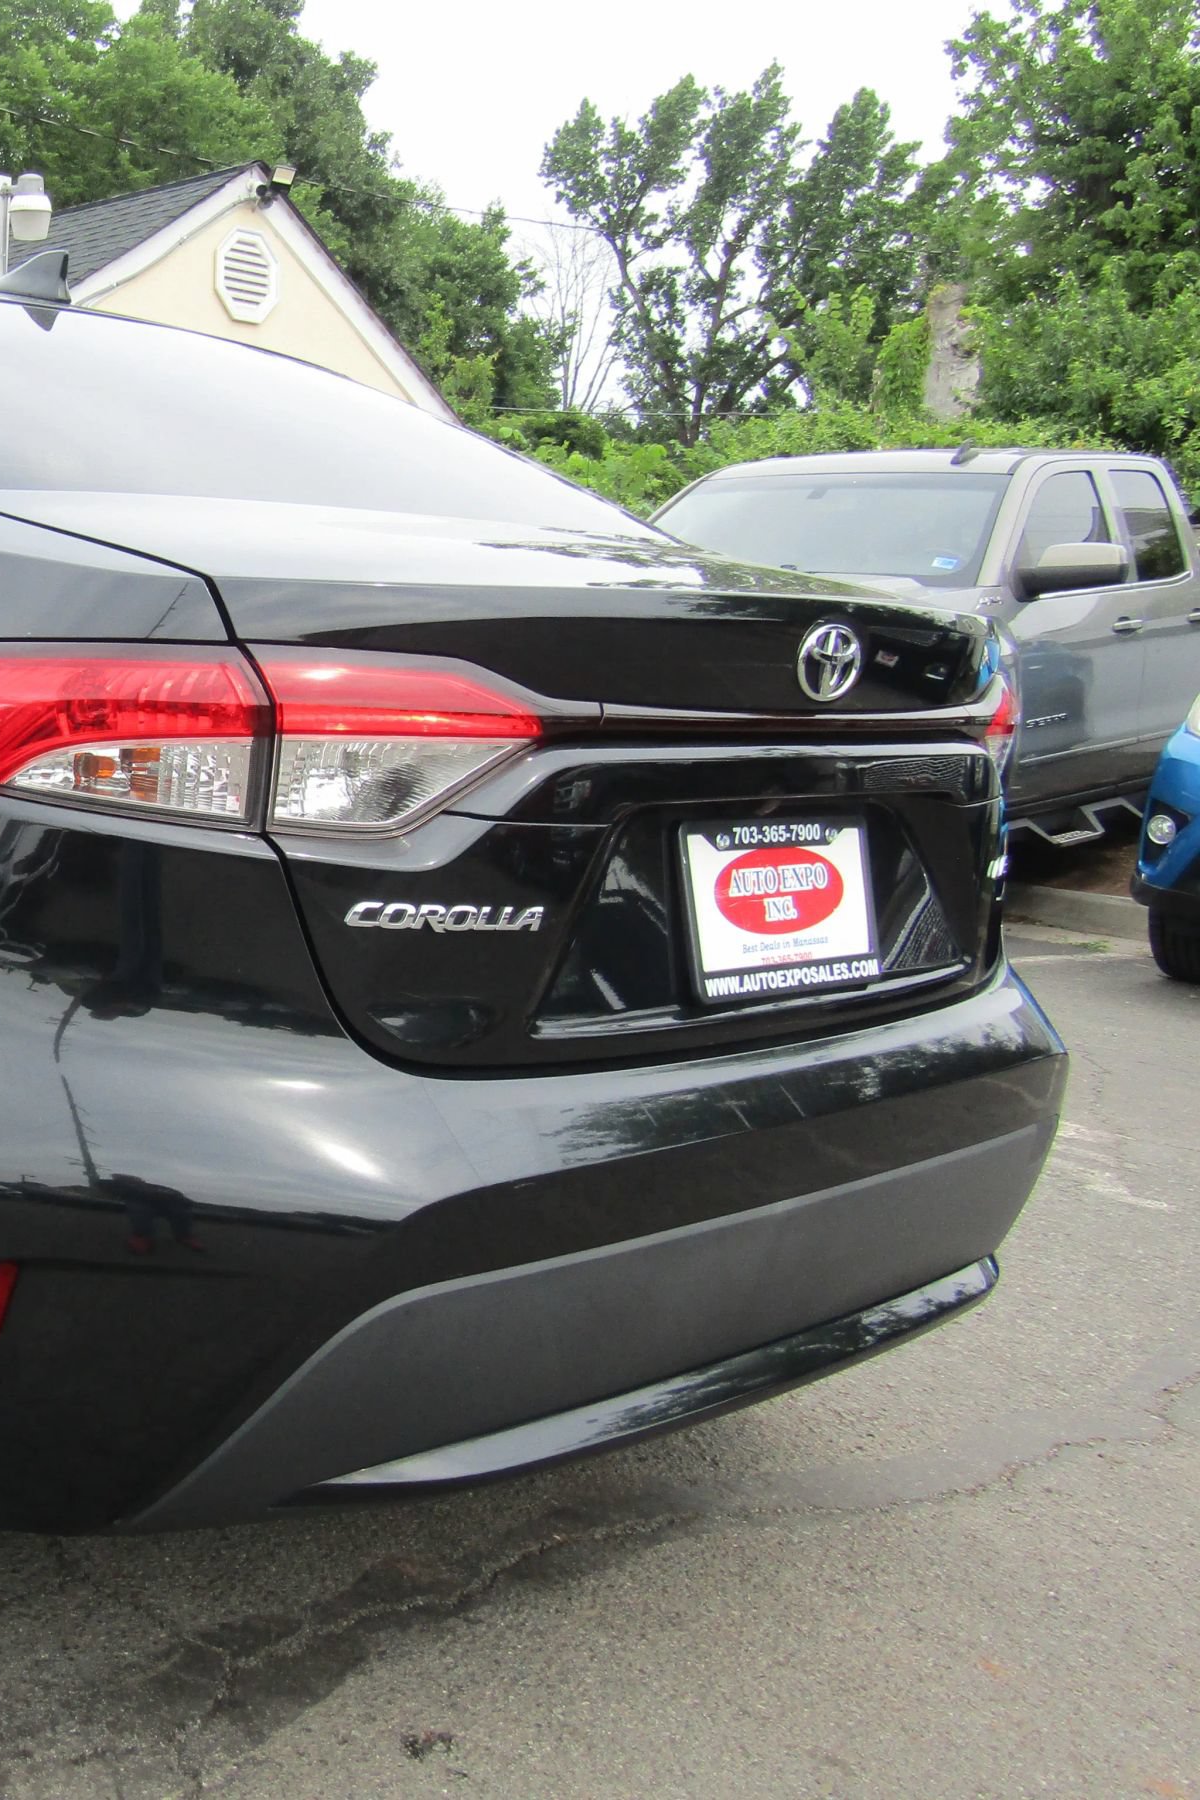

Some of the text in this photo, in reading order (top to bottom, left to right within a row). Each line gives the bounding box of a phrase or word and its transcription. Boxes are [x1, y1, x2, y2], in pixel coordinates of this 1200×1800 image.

[732, 823, 820, 845] 703-365-7900
[730, 863, 827, 896] AUTO EXPO
[344, 901, 545, 934] COROLLA
[765, 897, 796, 920] INC.
[742, 943, 758, 954] Best
[760, 940, 780, 952] Deals
[782, 940, 791, 949] in
[704, 959, 880, 997] WWW.AUTOEXPOSALES.COM
